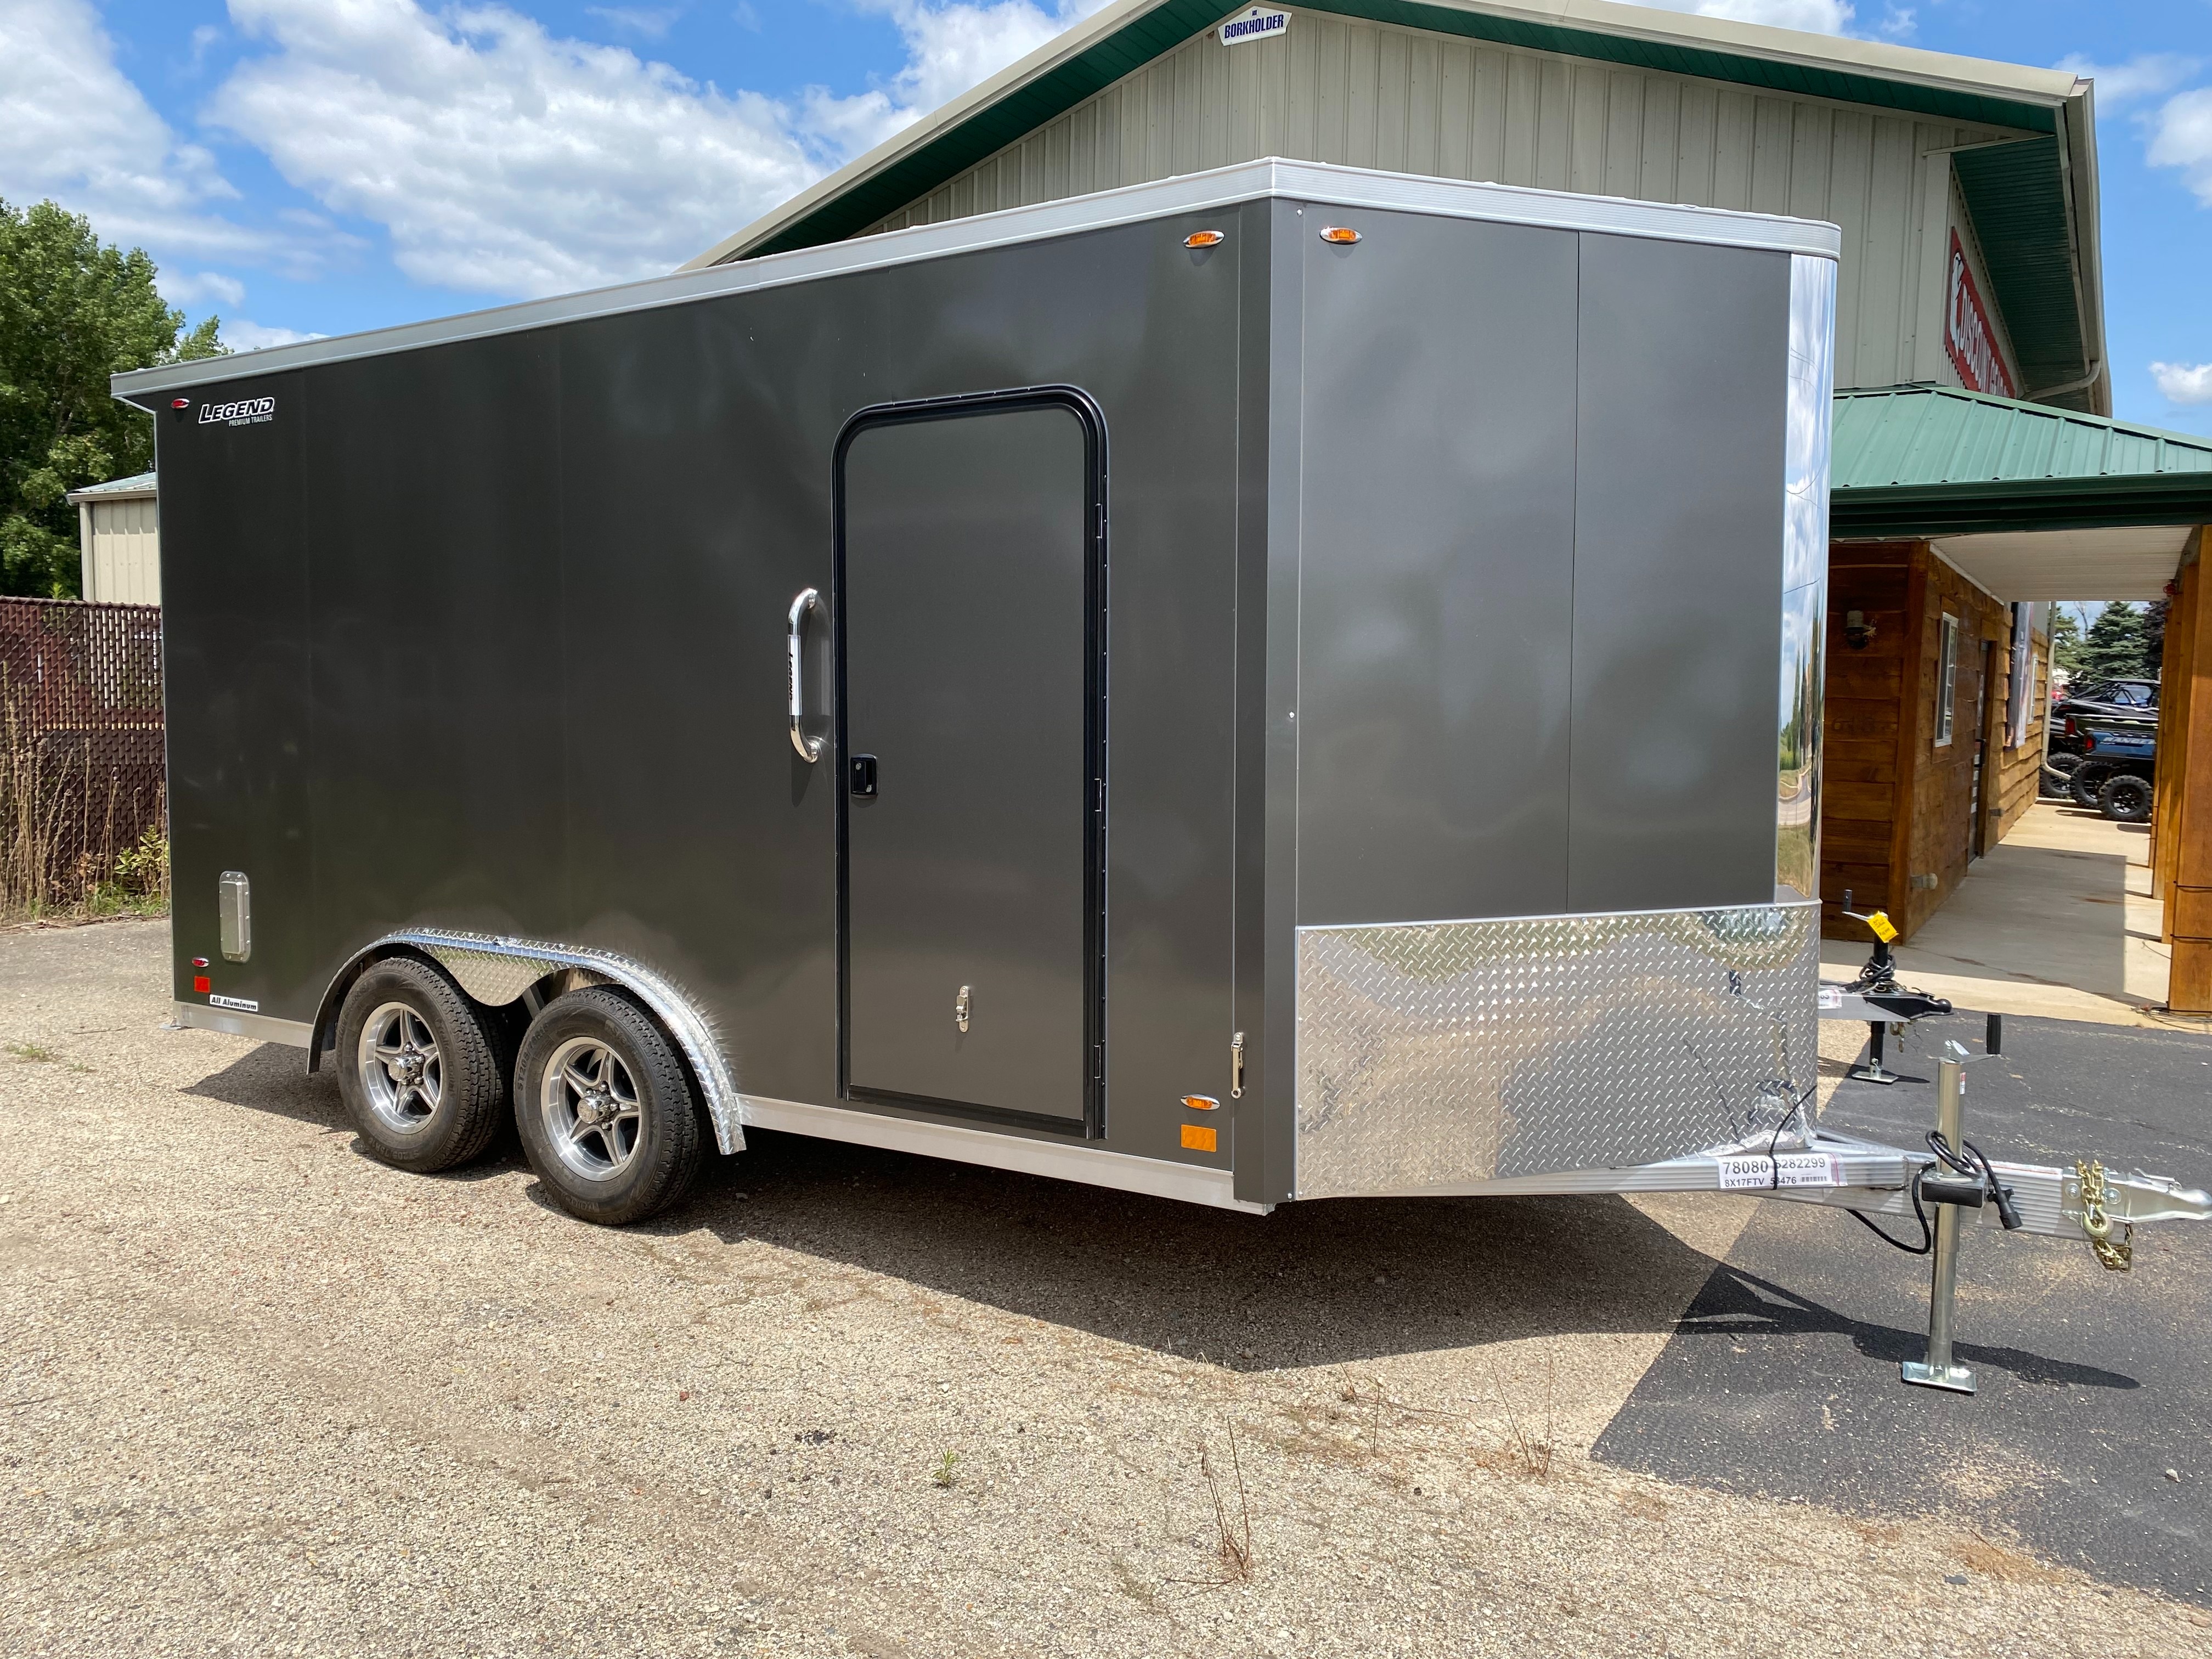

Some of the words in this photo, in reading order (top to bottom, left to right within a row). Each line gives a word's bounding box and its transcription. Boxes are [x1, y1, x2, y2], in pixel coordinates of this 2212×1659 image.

[1224, 14, 1284, 39] BORKHOLDER
[198, 397, 275, 424] LEGEND
[228, 417, 251, 427] PREMIUM
[251, 414, 273, 424] TRAILERS
[223, 998, 257, 1010] Aluminum
[1723, 1160, 1769, 1175] 78080
[1725, 1178, 1765, 1187] 8X17FTV
